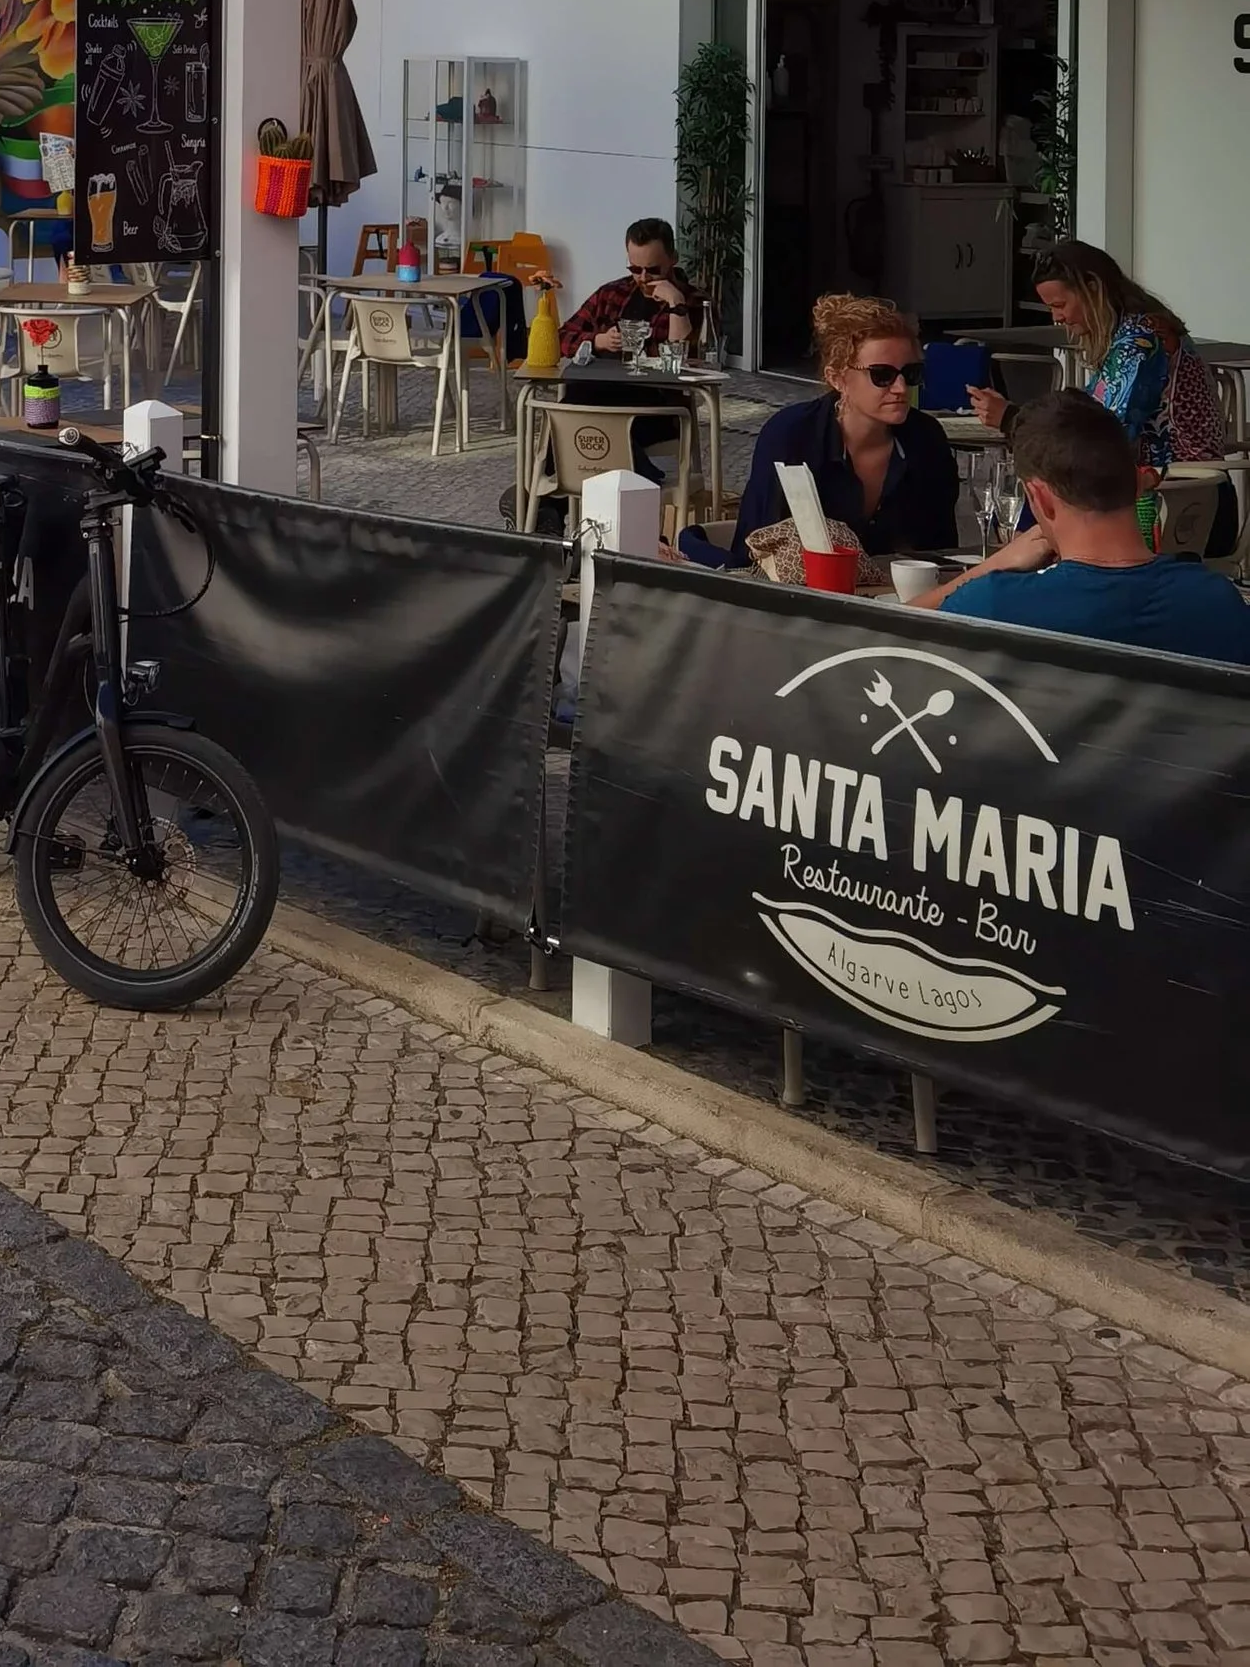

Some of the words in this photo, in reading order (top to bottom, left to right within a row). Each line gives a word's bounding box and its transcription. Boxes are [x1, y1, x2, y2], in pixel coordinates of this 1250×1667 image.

[88, 13, 119, 28] Cocktails
[123, 220, 139, 236] Beer
[578, 435, 605, 444] SUPER
[580, 442, 605, 451] BOCK
[705, 735, 888, 862] SANTA
[912, 787, 1135, 932] MARIA
[780, 844, 944, 929] Restaurante
[975, 899, 1037, 956] Bar
[827, 940, 910, 1001] Algarve
[919, 977, 983, 1015] Lagos
